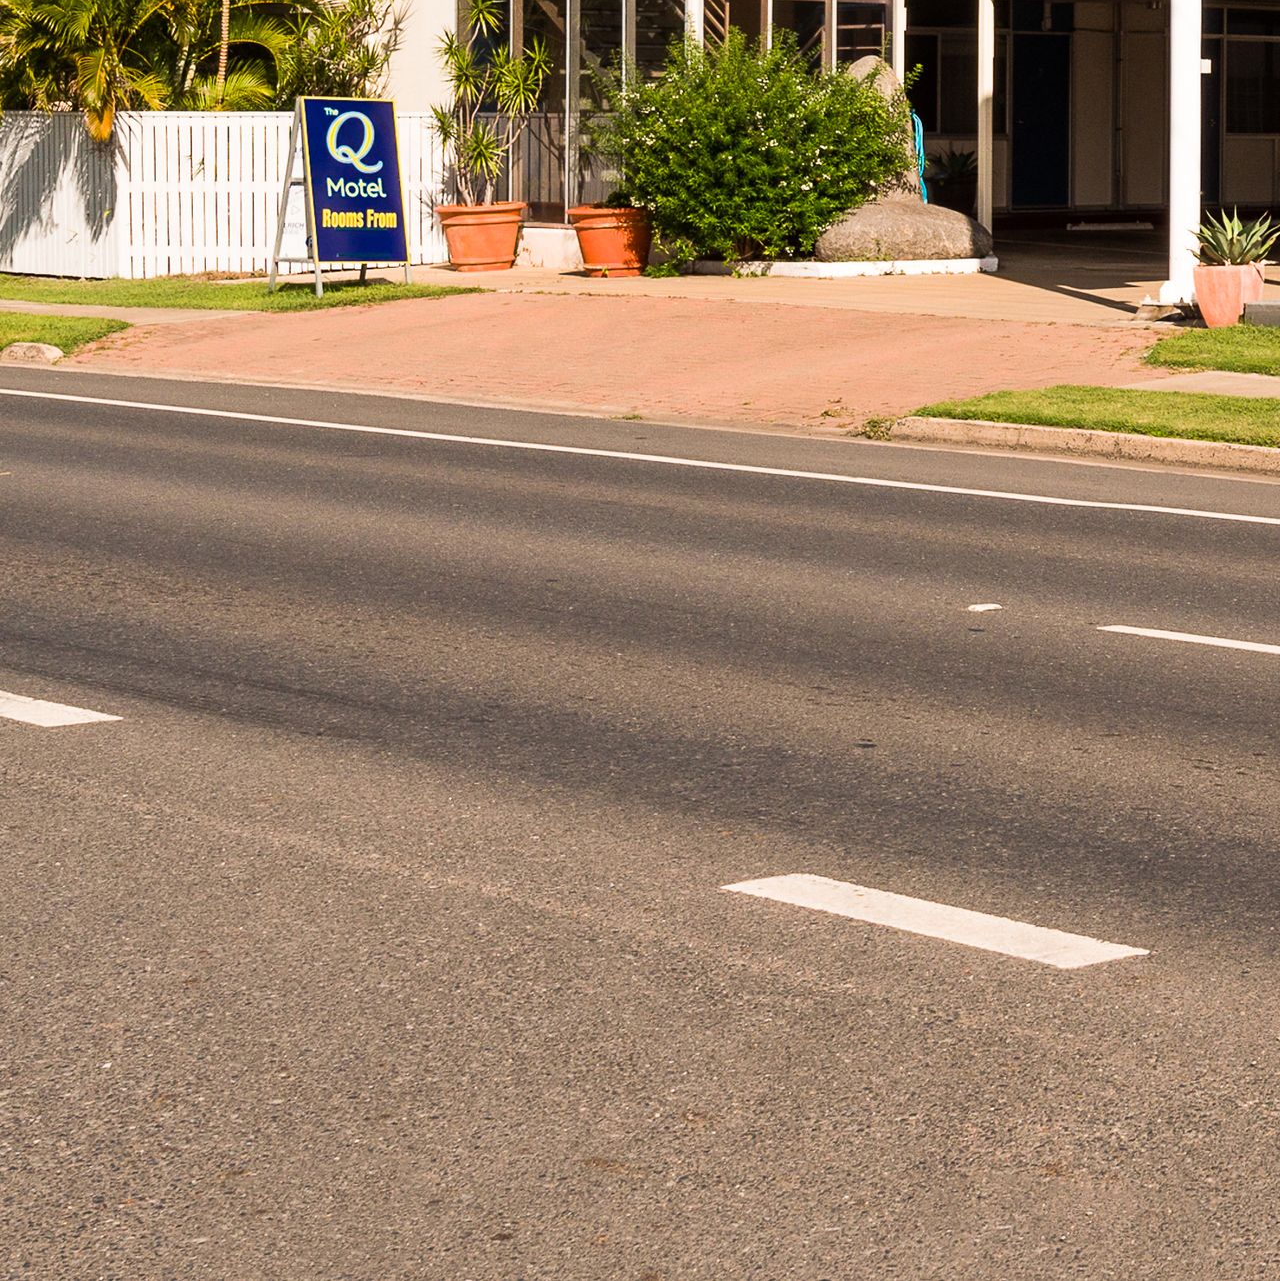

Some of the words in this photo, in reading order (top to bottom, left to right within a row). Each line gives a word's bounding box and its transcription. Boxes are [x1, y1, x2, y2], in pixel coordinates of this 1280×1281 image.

[326, 111, 384, 174] Q
[326, 177, 387, 198] Motel
[322, 208, 364, 228] Rooms
[366, 209, 397, 229] From
